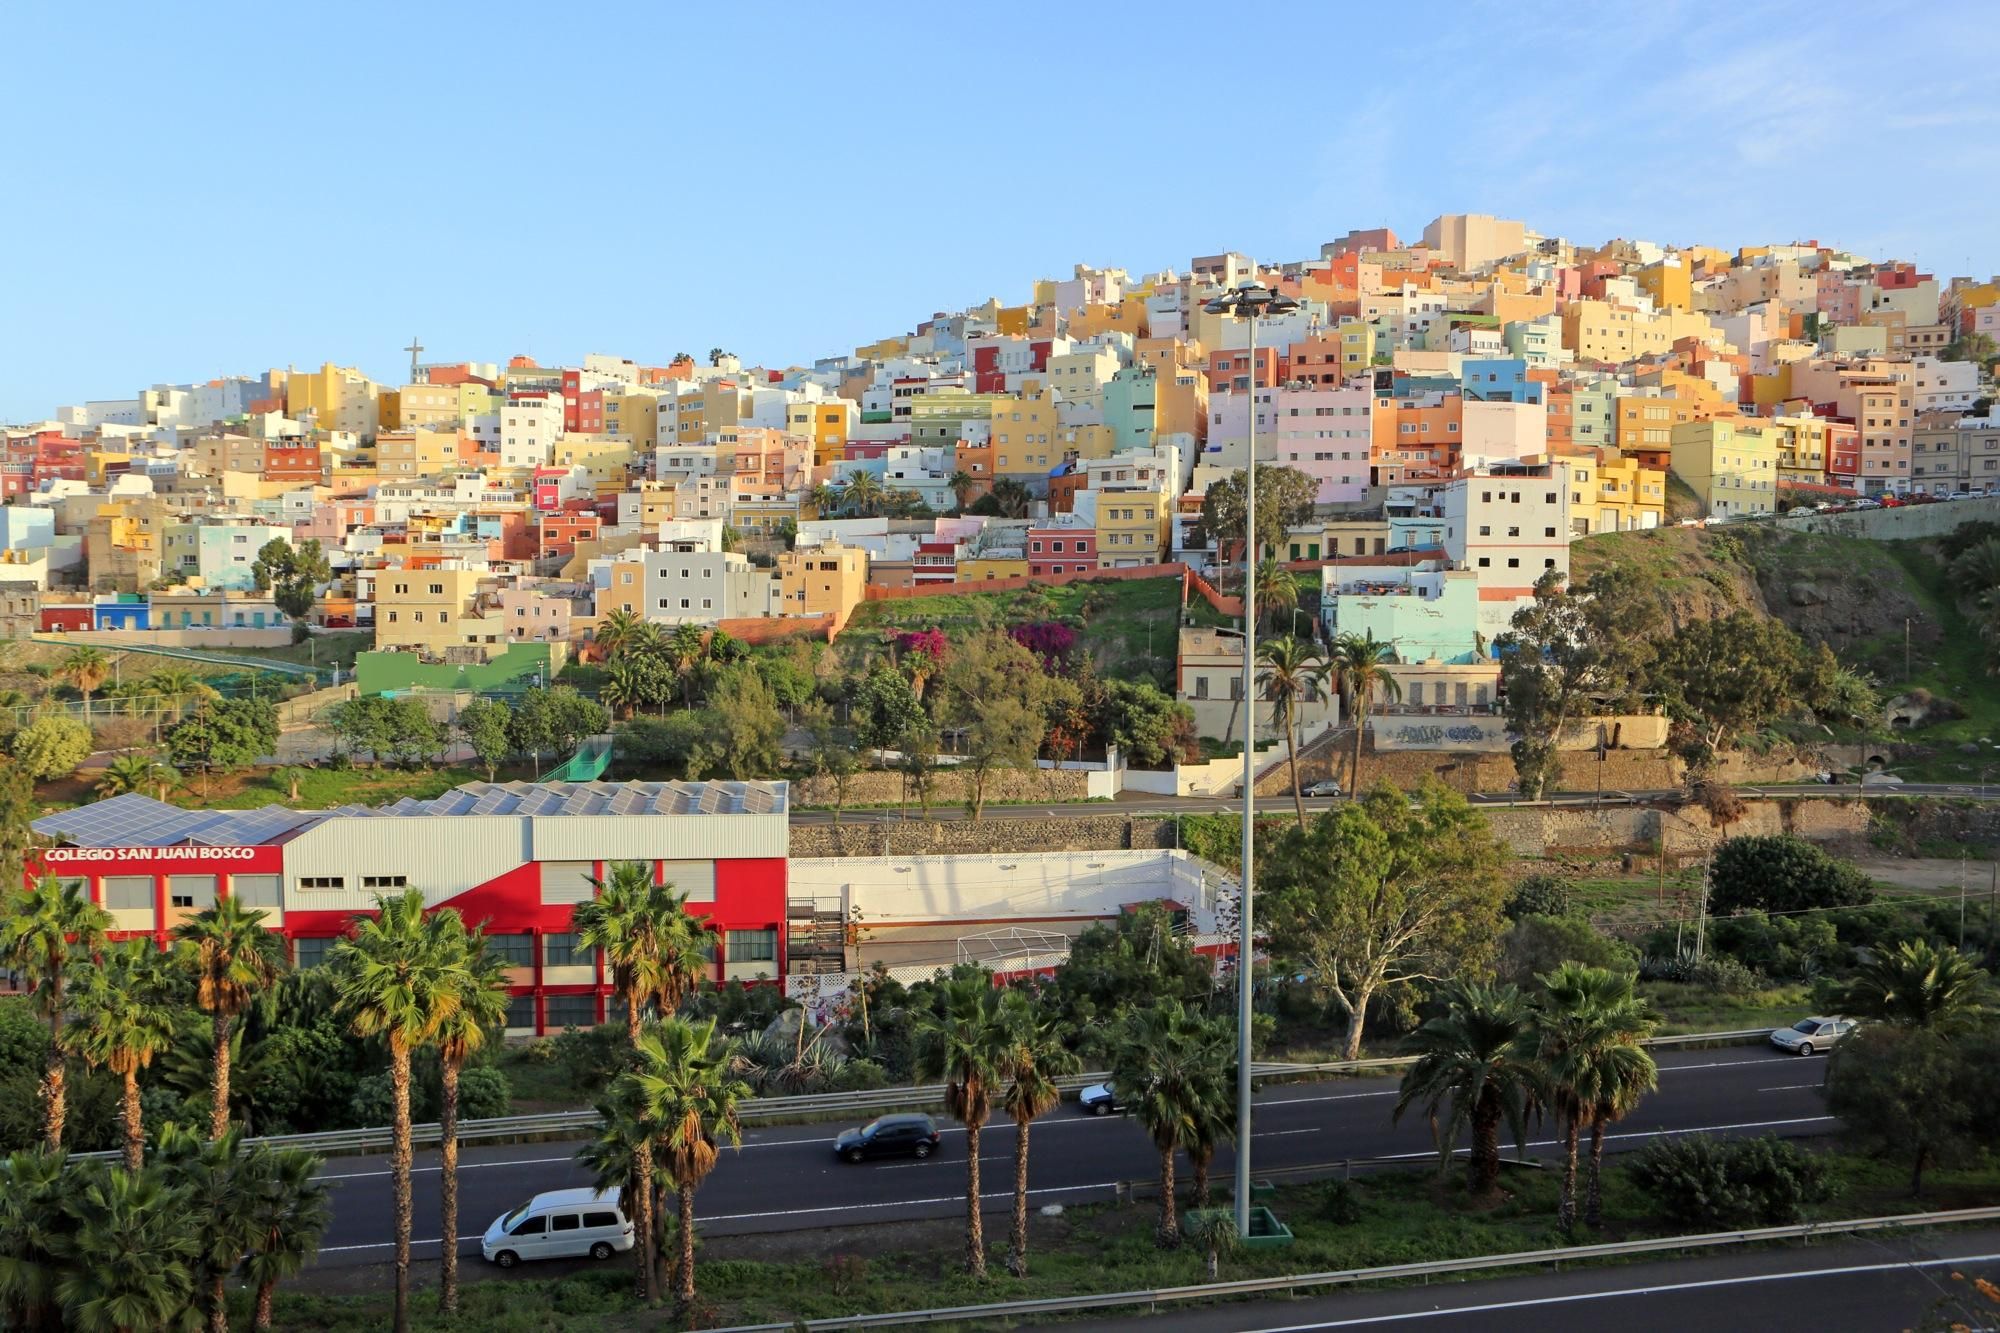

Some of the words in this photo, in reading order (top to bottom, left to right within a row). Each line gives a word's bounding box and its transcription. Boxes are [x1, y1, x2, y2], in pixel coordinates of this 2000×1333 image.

[44, 848, 115, 862] COLEGIO
[117, 848, 152, 861] SAN
[154, 847, 198, 860] JUAN
[199, 847, 255, 859] BOSCO
